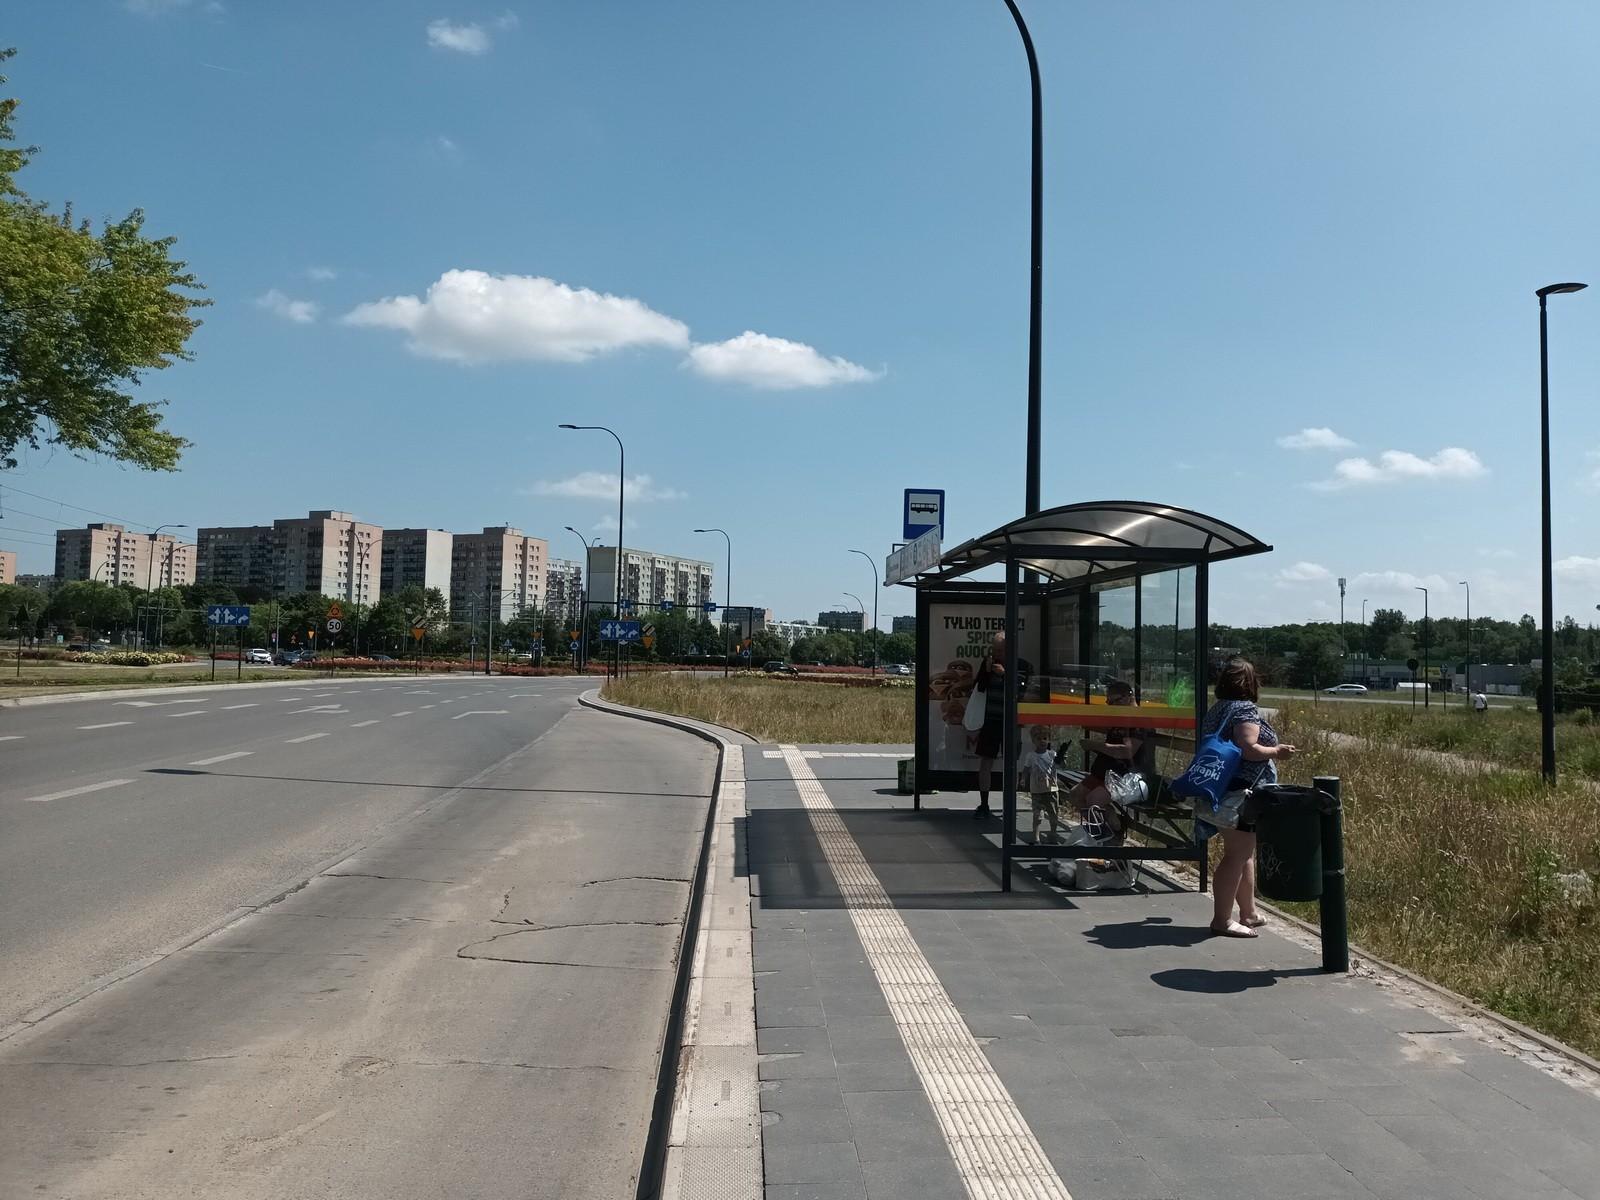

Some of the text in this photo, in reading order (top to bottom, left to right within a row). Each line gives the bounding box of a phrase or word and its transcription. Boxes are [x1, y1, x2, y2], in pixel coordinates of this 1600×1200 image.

[329, 621, 341, 630] 50
[943, 616, 1025, 631] TYLKO TERZ!
[967, 631, 997, 644] SPIC
[956, 645, 993, 658] AVOCA
